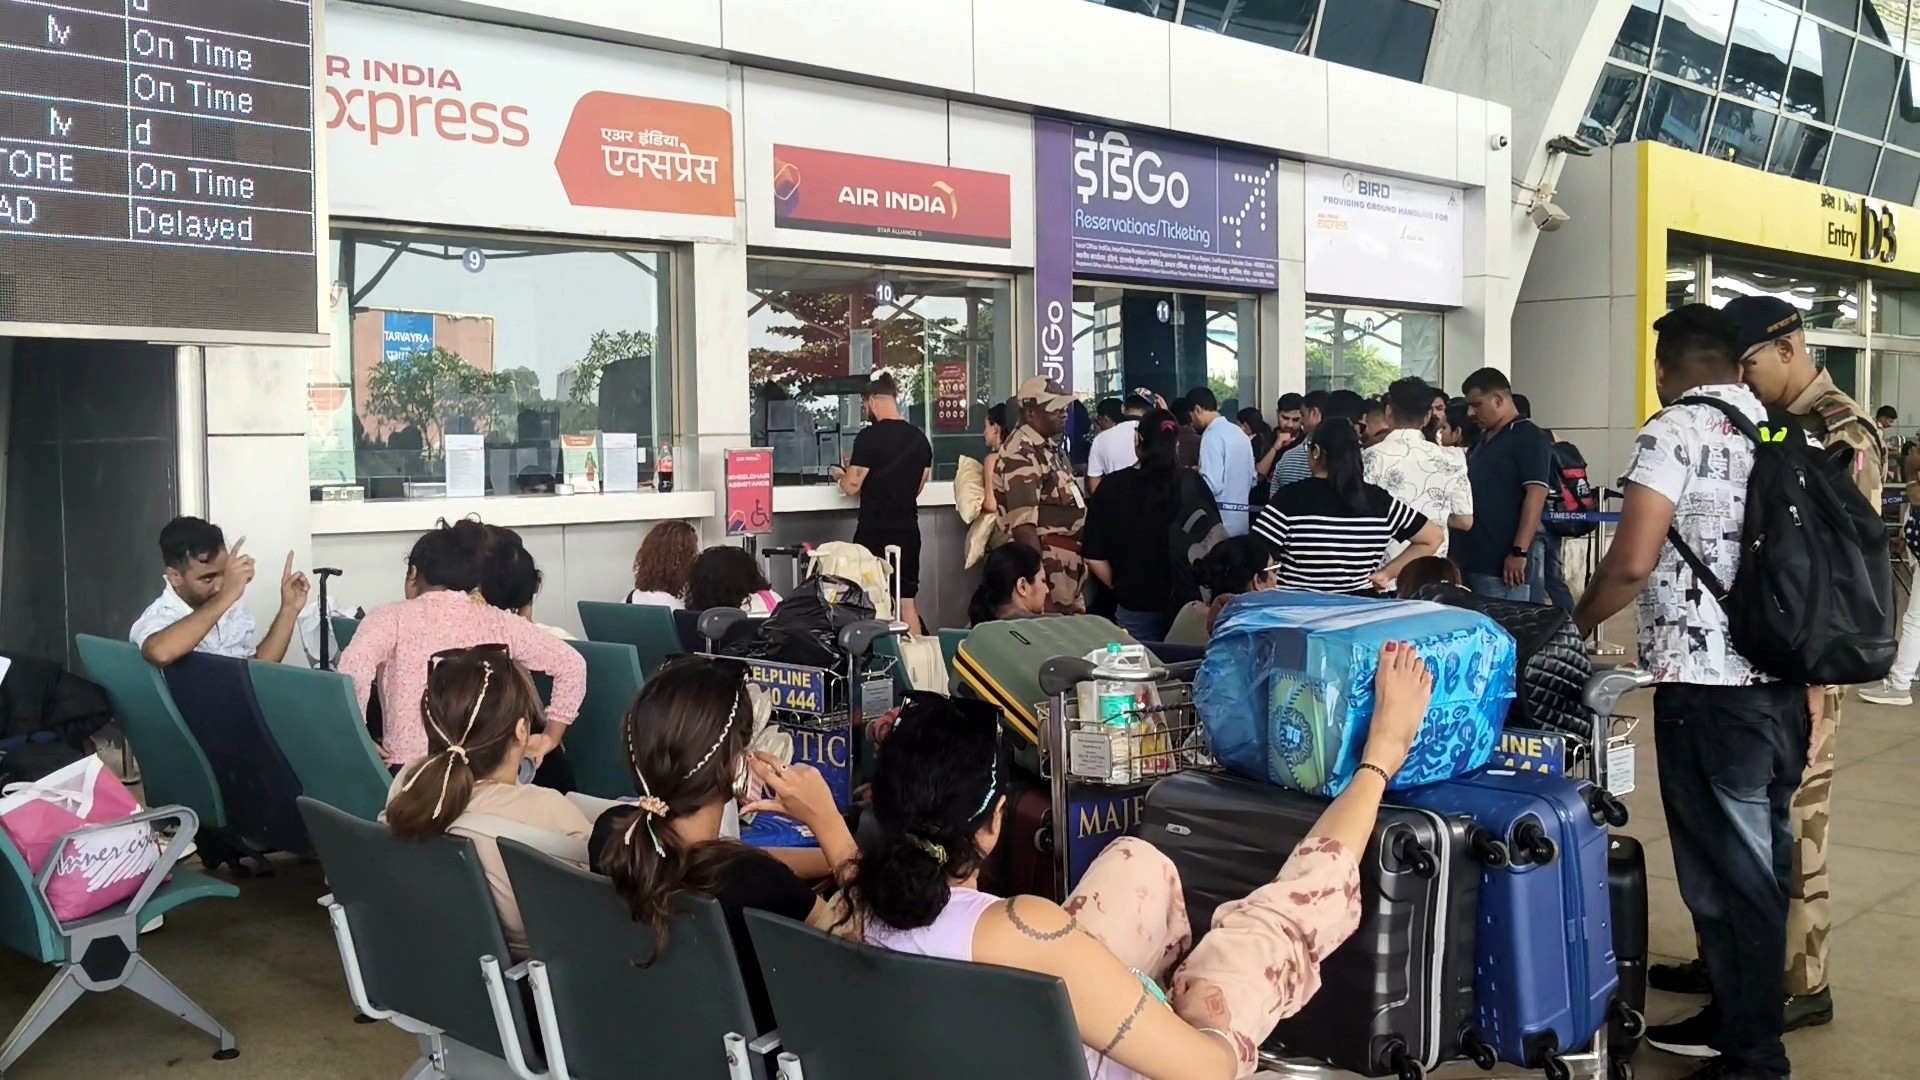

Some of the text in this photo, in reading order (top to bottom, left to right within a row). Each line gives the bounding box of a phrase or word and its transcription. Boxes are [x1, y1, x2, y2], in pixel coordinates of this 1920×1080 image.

[133, 28, 252, 71] On Time
[363, 59, 462, 92] INDIA
[134, 73, 253, 114] On Time
[325, 85, 529, 147] xpress
[600, 127, 679, 147] एअर इंडिया
[0, 147, 73, 181] ORE
[600, 142, 719, 185] एक्सप्रेस
[136, 162, 254, 199] On Time
[1358, 180, 1391, 200] BIRD
[838, 185, 947, 215] AIR INDIA
[1323, 195, 1365, 210] PROVIDING
[1366, 202, 1397, 214] GROUND
[1434, 213, 1449, 222] FOR
[136, 206, 252, 241] Delayed
[891, 228, 917, 237] ALLIANCE
[1075, 208, 1211, 248] Reservations/Ticketing
[1828, 222, 1857, 257] Entry
[1860, 198, 1898, 263] D3
[469, 250, 481, 269] 9
[876, 284, 892, 302] 10
[1156, 304, 1169, 319] 11
[1041, 300, 1065, 391] diGo
[728, 480, 770, 488] ASSISTANCE
[750, 666, 811, 689] ELPLINE
[787, 689, 816, 711] 444
[790, 730, 846, 768] TIC
[1495, 733, 1542, 758] INE
